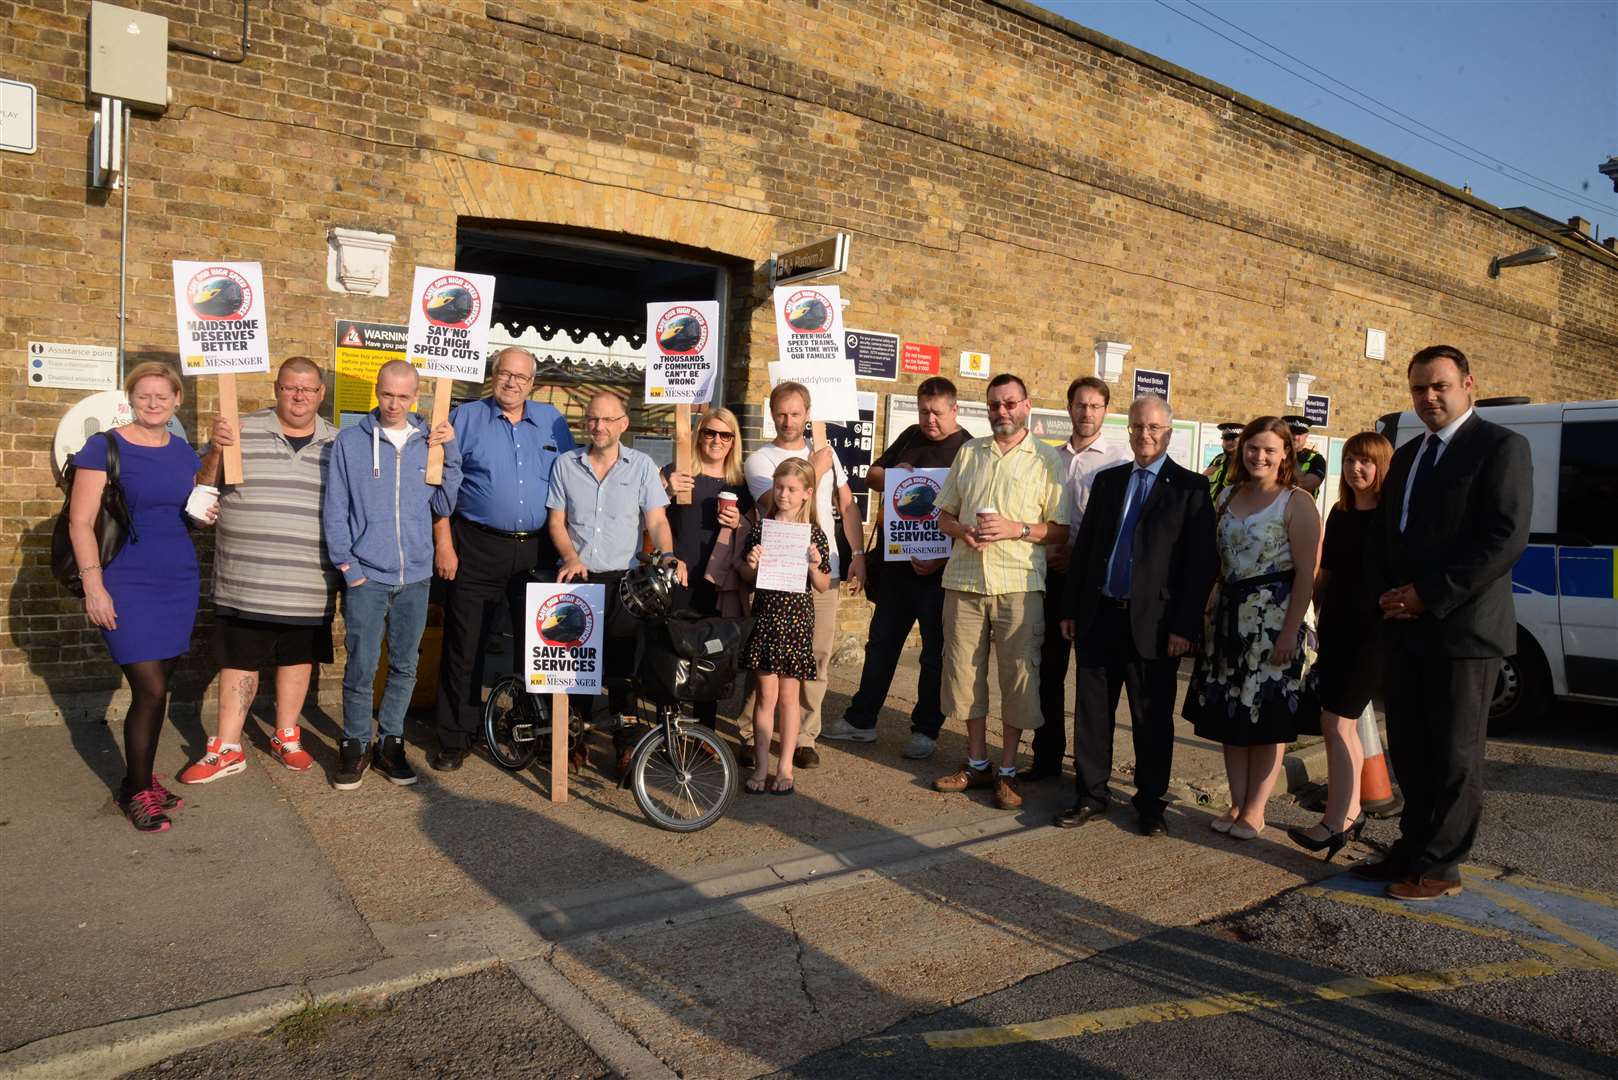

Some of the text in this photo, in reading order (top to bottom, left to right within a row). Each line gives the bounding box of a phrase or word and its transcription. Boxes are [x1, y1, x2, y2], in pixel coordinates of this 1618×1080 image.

[820, 248, 824, 262] 2
[210, 268, 229, 278] HIGH
[228, 271, 248, 288] SPEED
[434, 278, 448, 288] OUR
[447, 276, 464, 285] HIGH
[463, 282, 478, 300] SPEED
[791, 293, 802, 303] OUR
[815, 294, 830, 308] SPEED
[664, 310, 676, 320] OUR
[690, 310, 706, 326] SPEED
[187, 320, 258, 331] MAIDSTONE
[428, 326, 449, 336] SAY
[192, 330, 255, 342] DESERVES
[201, 341, 248, 352] BETTER
[426, 336, 470, 349] TO HIGH
[48, 346, 91, 356] Assistance
[414, 344, 480, 360] SPEED CUTS
[206, 357, 262, 367] MESSENGER
[428, 362, 479, 375] MESSENGER
[834, 438, 837, 447] 1
[902, 478, 913, 488] OUR
[890, 521, 938, 531] SAVE OU
[890, 532, 946, 542] SERVICES
[547, 597, 559, 608] OUR
[559, 594, 575, 602] HIGH
[575, 598, 590, 616] SPEED
[579, 615, 593, 643] SERVICES
[532, 646, 597, 659] SAVE OUR
[533, 660, 595, 672] SERVICES
[546, 678, 596, 687] MESSENGER
